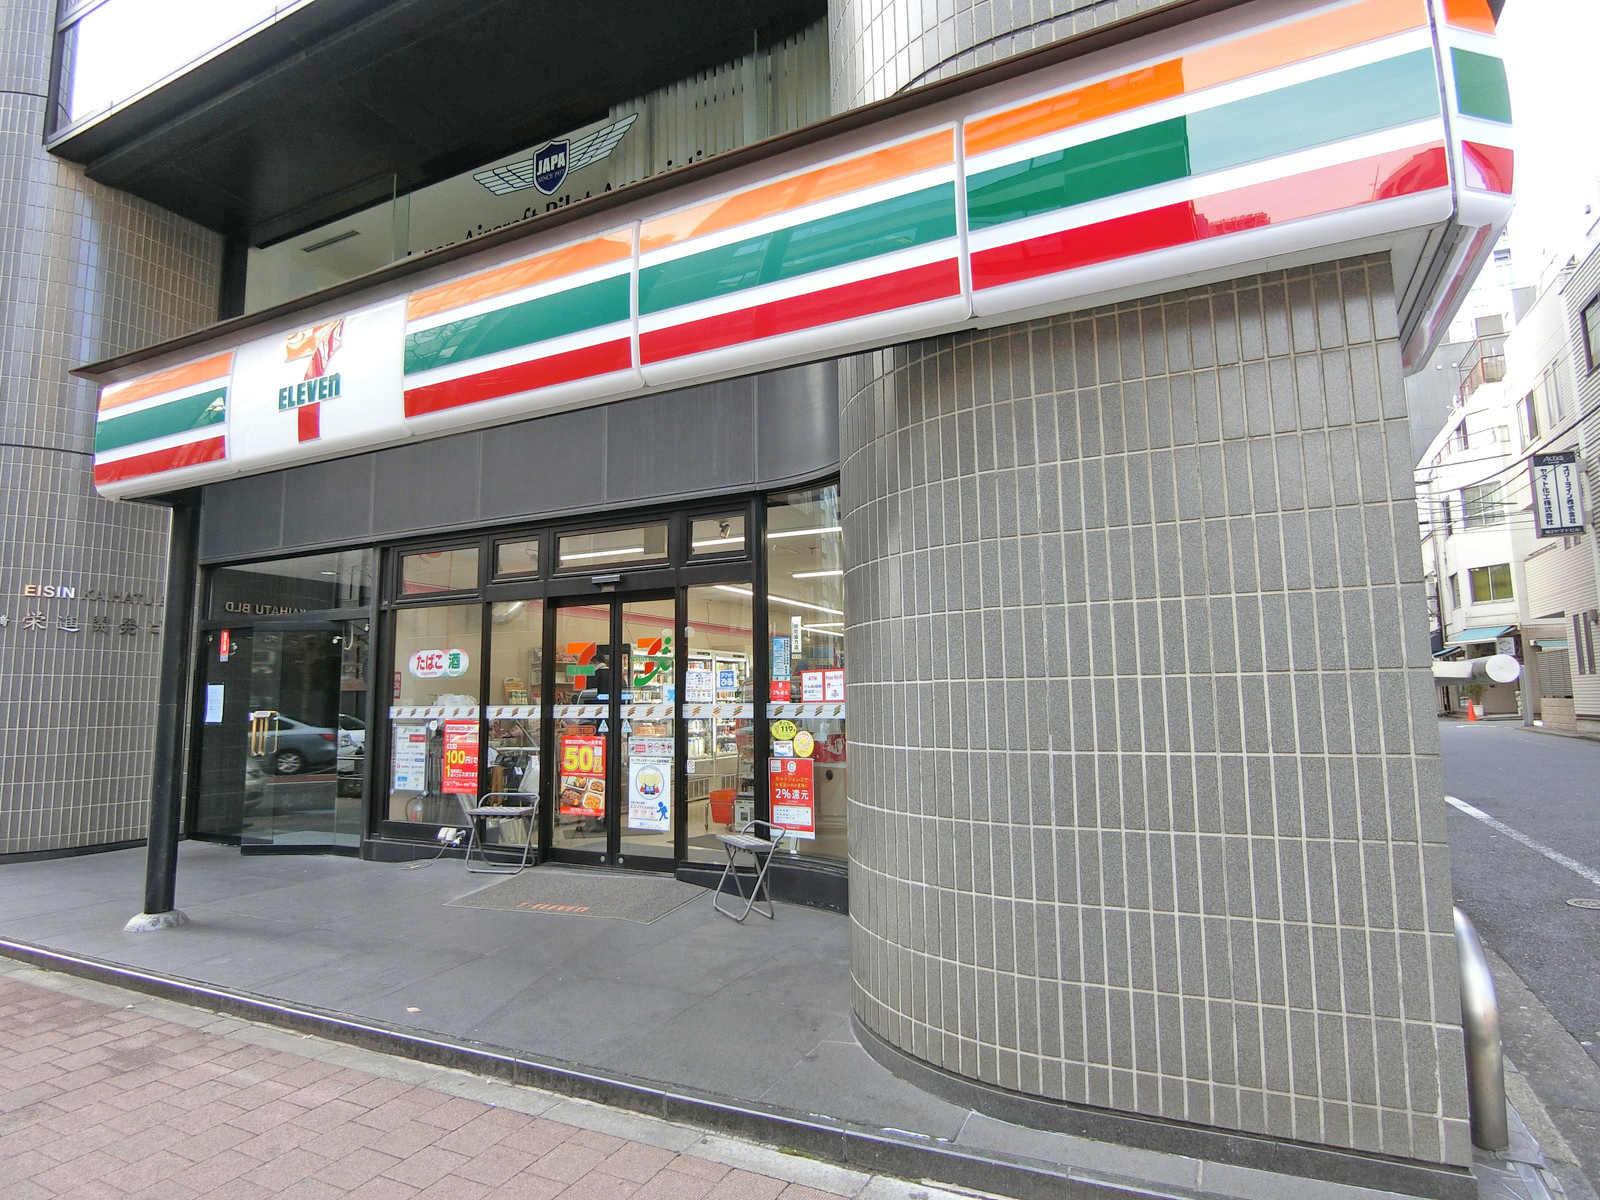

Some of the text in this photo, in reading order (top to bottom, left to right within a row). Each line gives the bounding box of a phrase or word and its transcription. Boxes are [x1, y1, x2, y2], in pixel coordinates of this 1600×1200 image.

[537, 152, 566, 176] JAPA
[1540, 468, 1554, 526] ヤマト化工株式会社
[1563, 465, 1577, 524] スリーライン株式会社
[24, 584, 76, 599] EISIN
[416, 652, 461, 670] たばこ 酒
[775, 788, 809, 800] 2%還元
